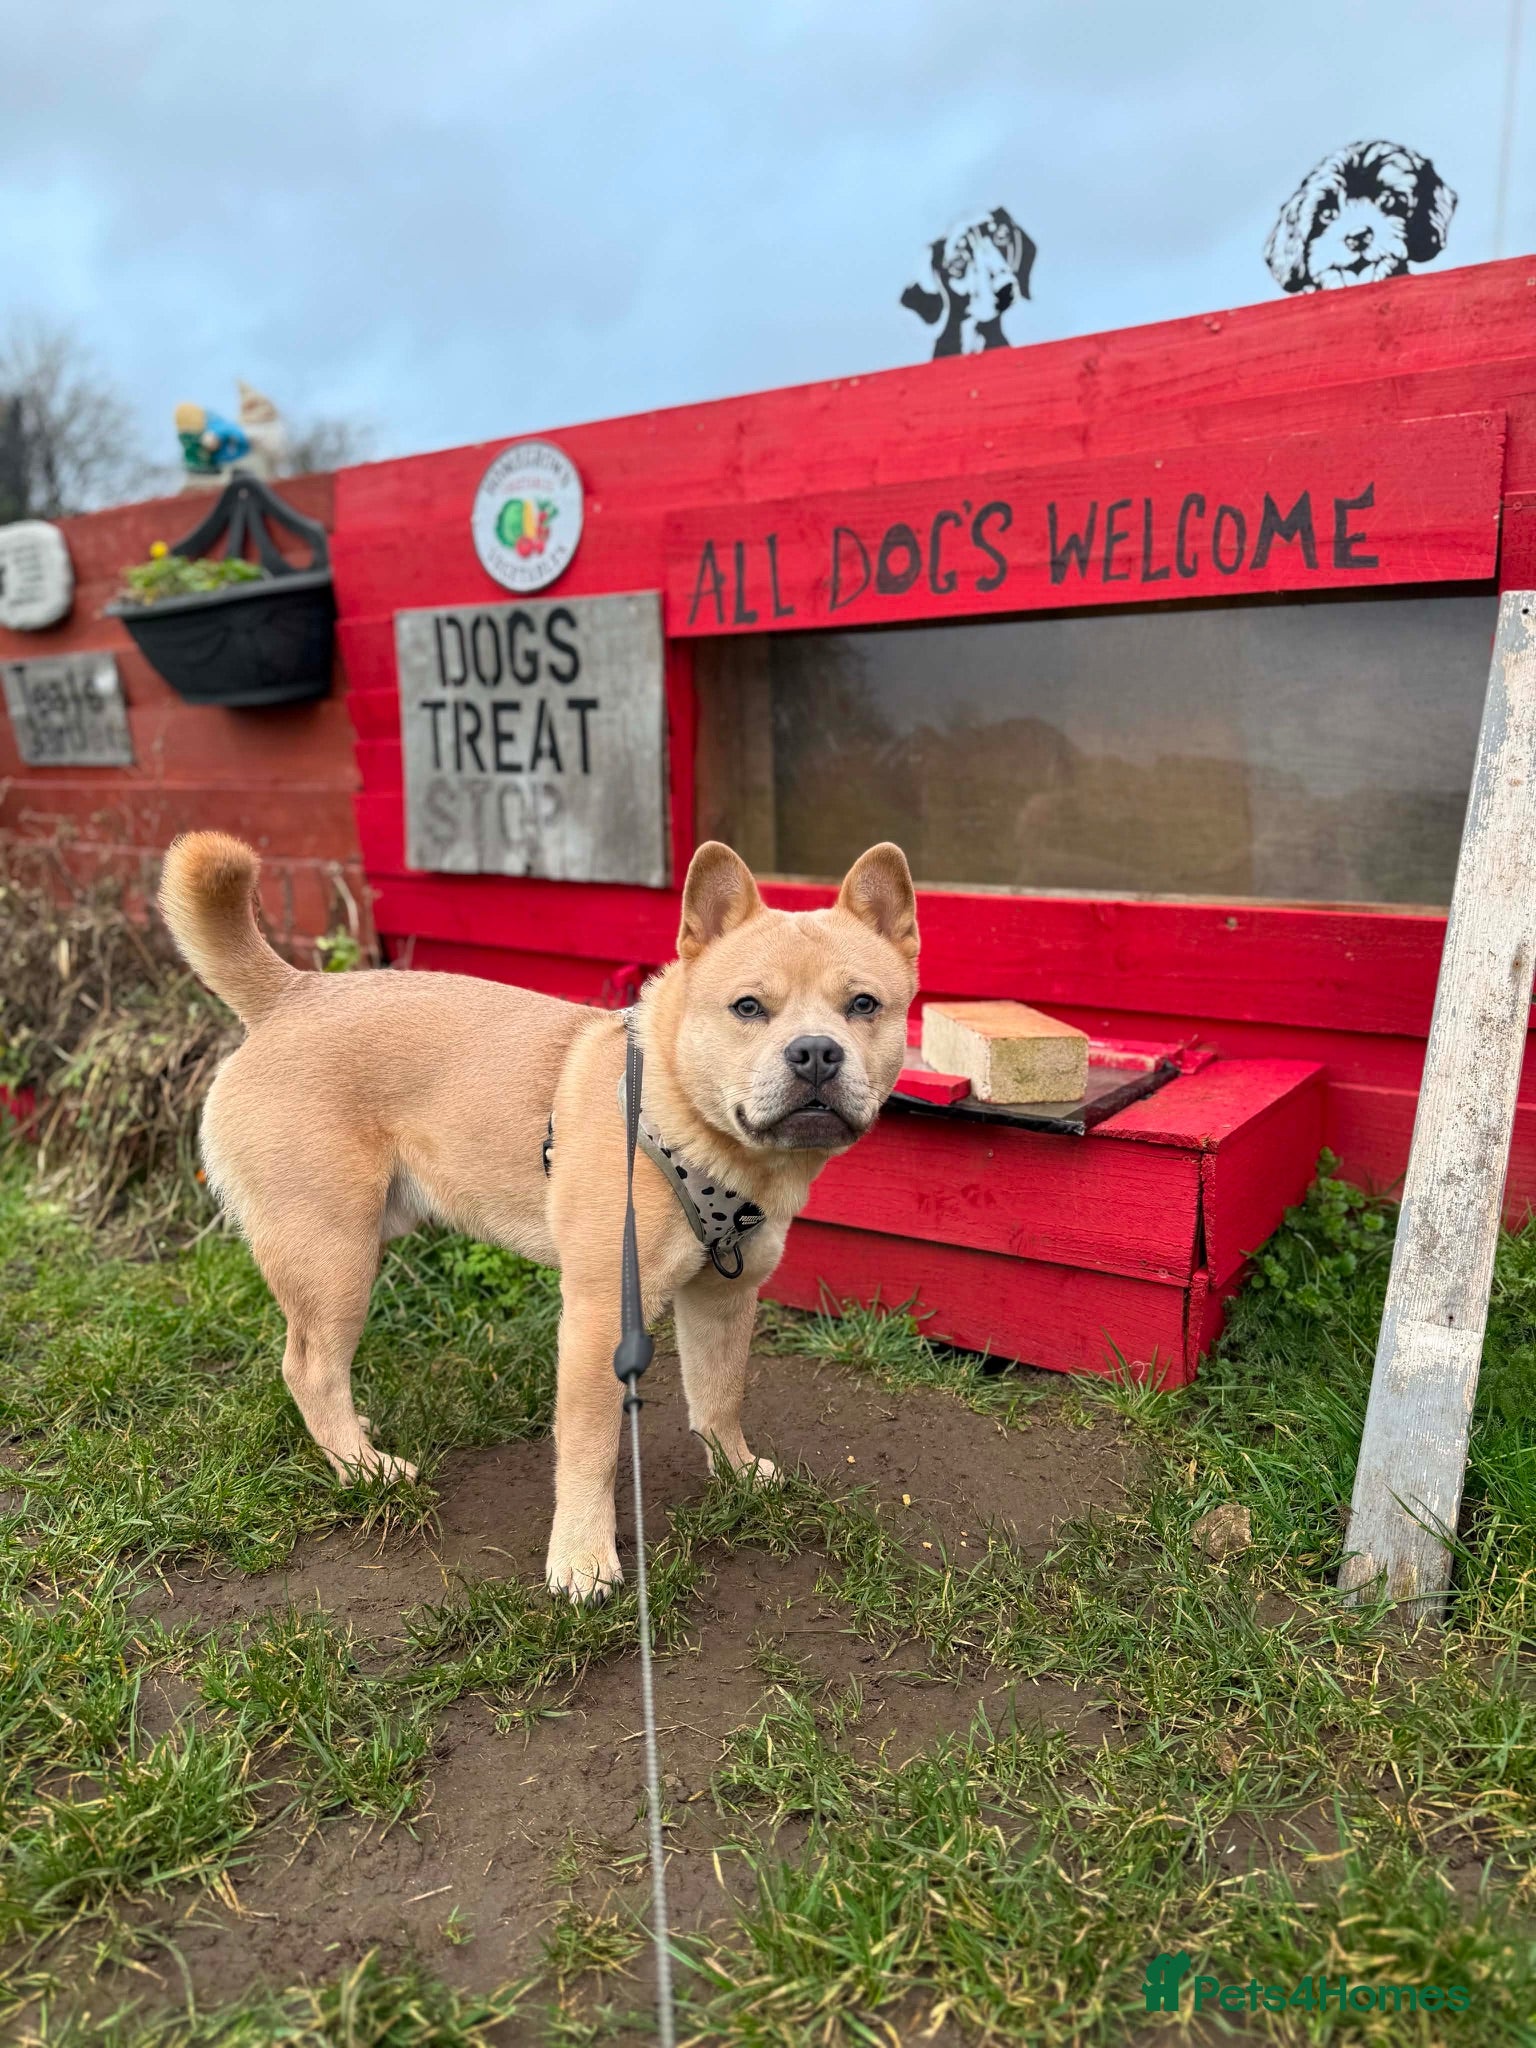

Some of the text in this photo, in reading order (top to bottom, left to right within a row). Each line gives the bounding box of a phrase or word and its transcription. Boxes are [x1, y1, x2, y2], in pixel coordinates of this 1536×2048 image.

[688, 481, 1381, 626] ALL DOG'S WELCOME
[435, 606, 581, 687] DOGS
[420, 697, 599, 775] TREAT
[421, 777, 563, 856] STOP
